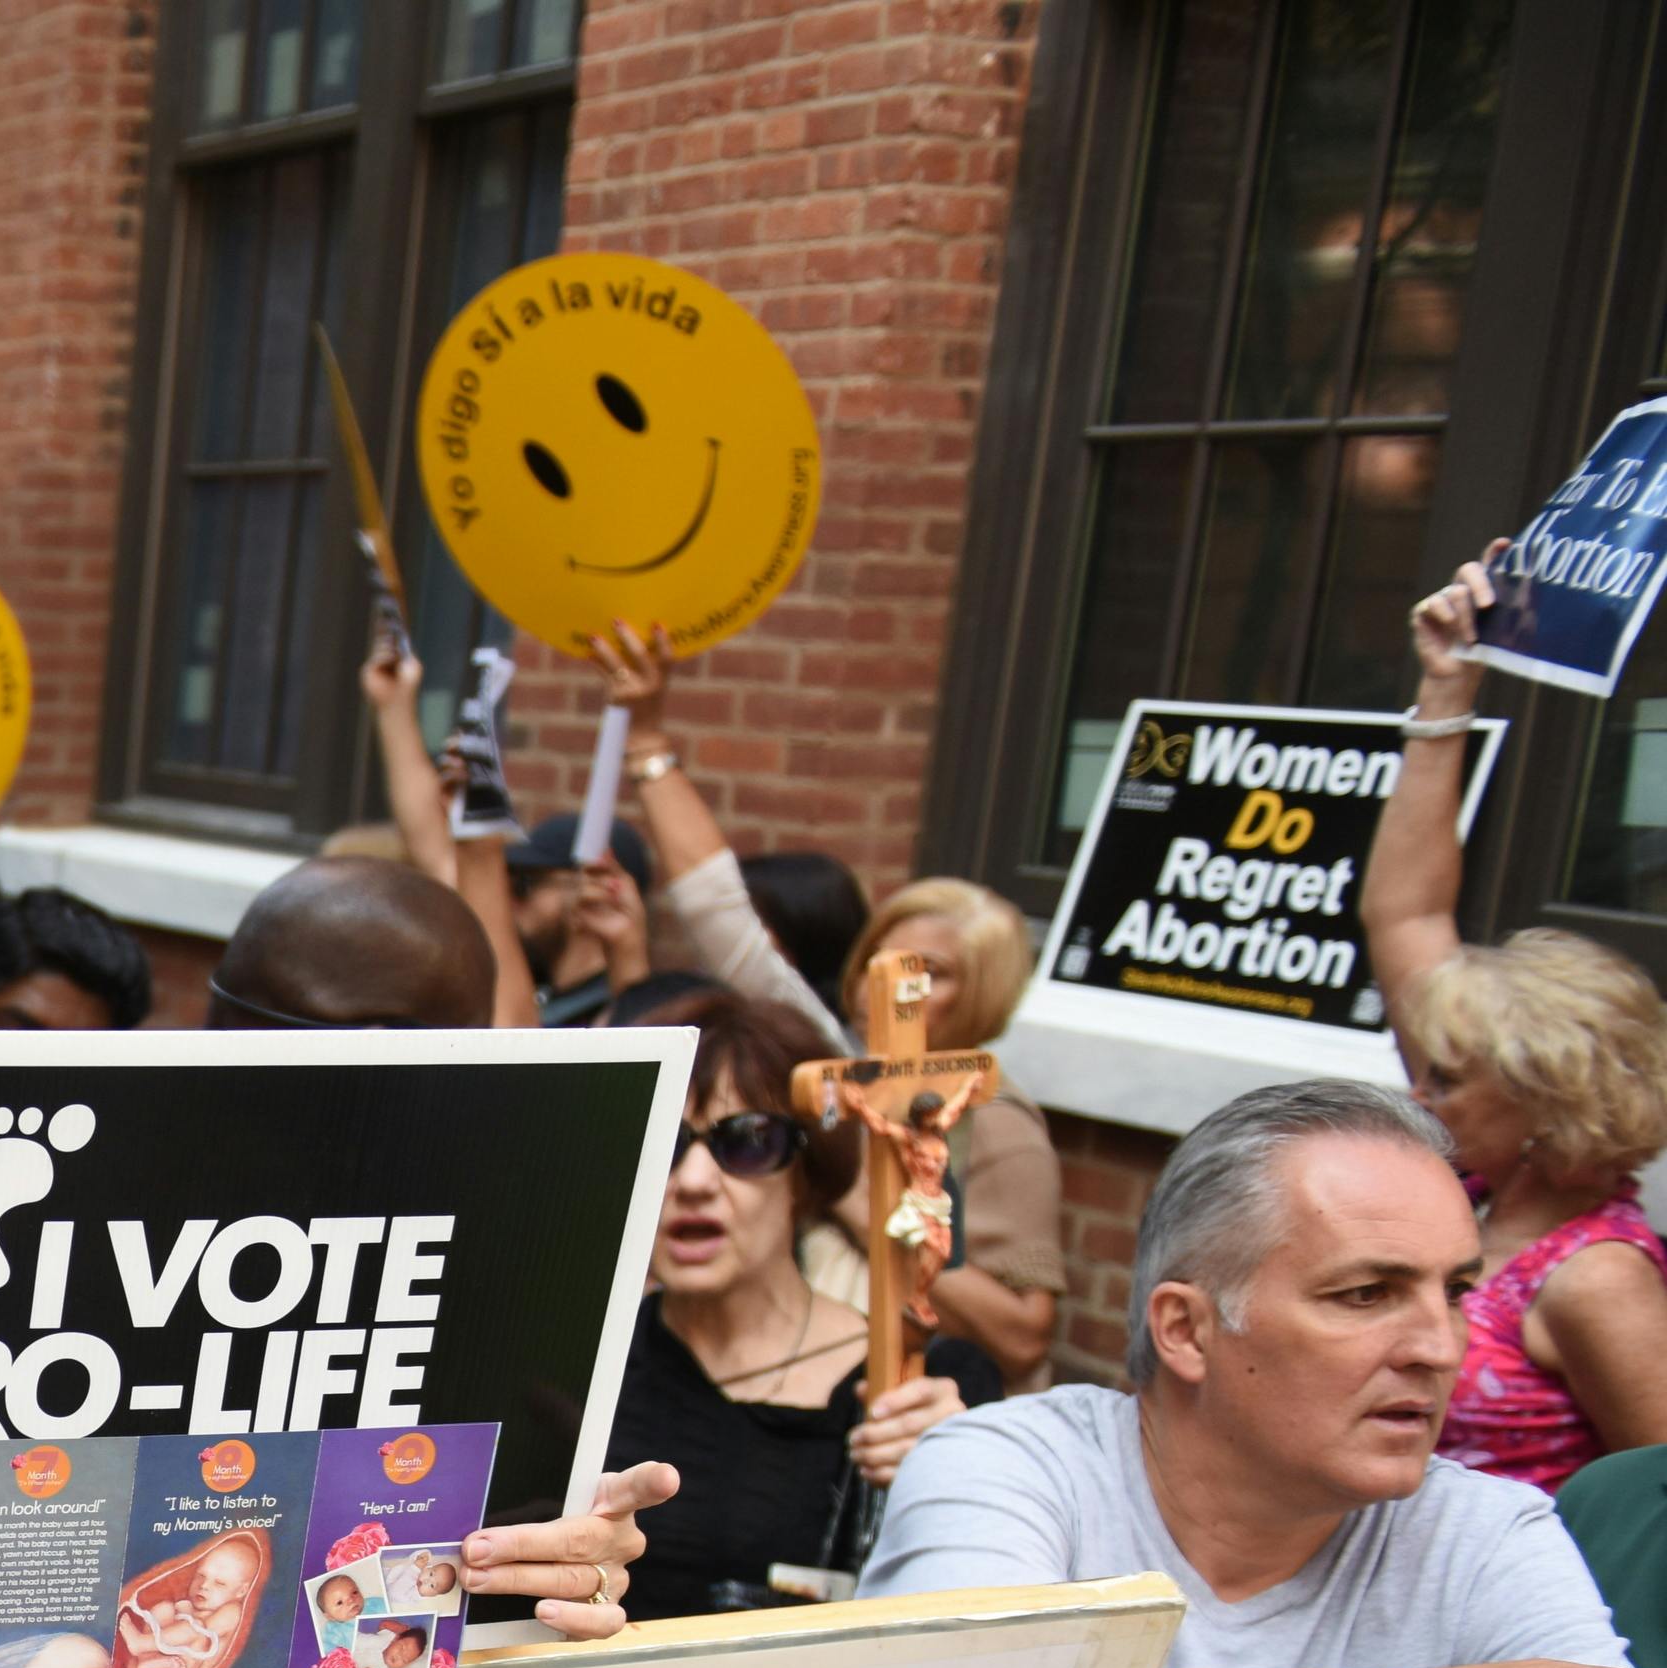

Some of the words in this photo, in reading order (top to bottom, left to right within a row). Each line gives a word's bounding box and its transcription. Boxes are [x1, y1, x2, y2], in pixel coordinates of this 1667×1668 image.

[519, 297, 545, 327] a
[549, 279, 593, 313] la
[605, 276, 703, 337] vida
[438, 367, 481, 462] digo
[1593, 458, 1645, 510] To
[450, 474, 481, 530] Yo
[1494, 509, 1655, 598] Abortion
[1188, 724, 1404, 799] Women
[1225, 789, 1314, 855] Do
[1156, 836, 1354, 921] Regret
[1101, 899, 1357, 989] Abortion
[920, 1054, 992, 1074] JESUCRISTO
[29, 1220, 73, 1329] I
[107, 1214, 456, 1331] VOTE
[27, 1471, 57, 1480] Month
[29, 1451, 60, 1493] 7
[213, 1465, 242, 1474] Month
[395, 1457, 422, 1466] Month
[11, 1501, 41, 1515] look
[179, 1497, 200, 1511] like
[204, 1497, 220, 1510] to
[223, 1495, 257, 1509] listen
[261, 1494, 277, 1507] to
[397, 1500, 405, 1513] I
[4, 1522, 27, 1530] month
[29, 1521, 41, 1529] the
[42, 1521, 62, 1529] baby
[153, 1522, 171, 1536] my
[174, 1516, 233, 1533] Mommy's
[47, 1578, 76, 1586] growing
[78, 1577, 101, 1585] longer
